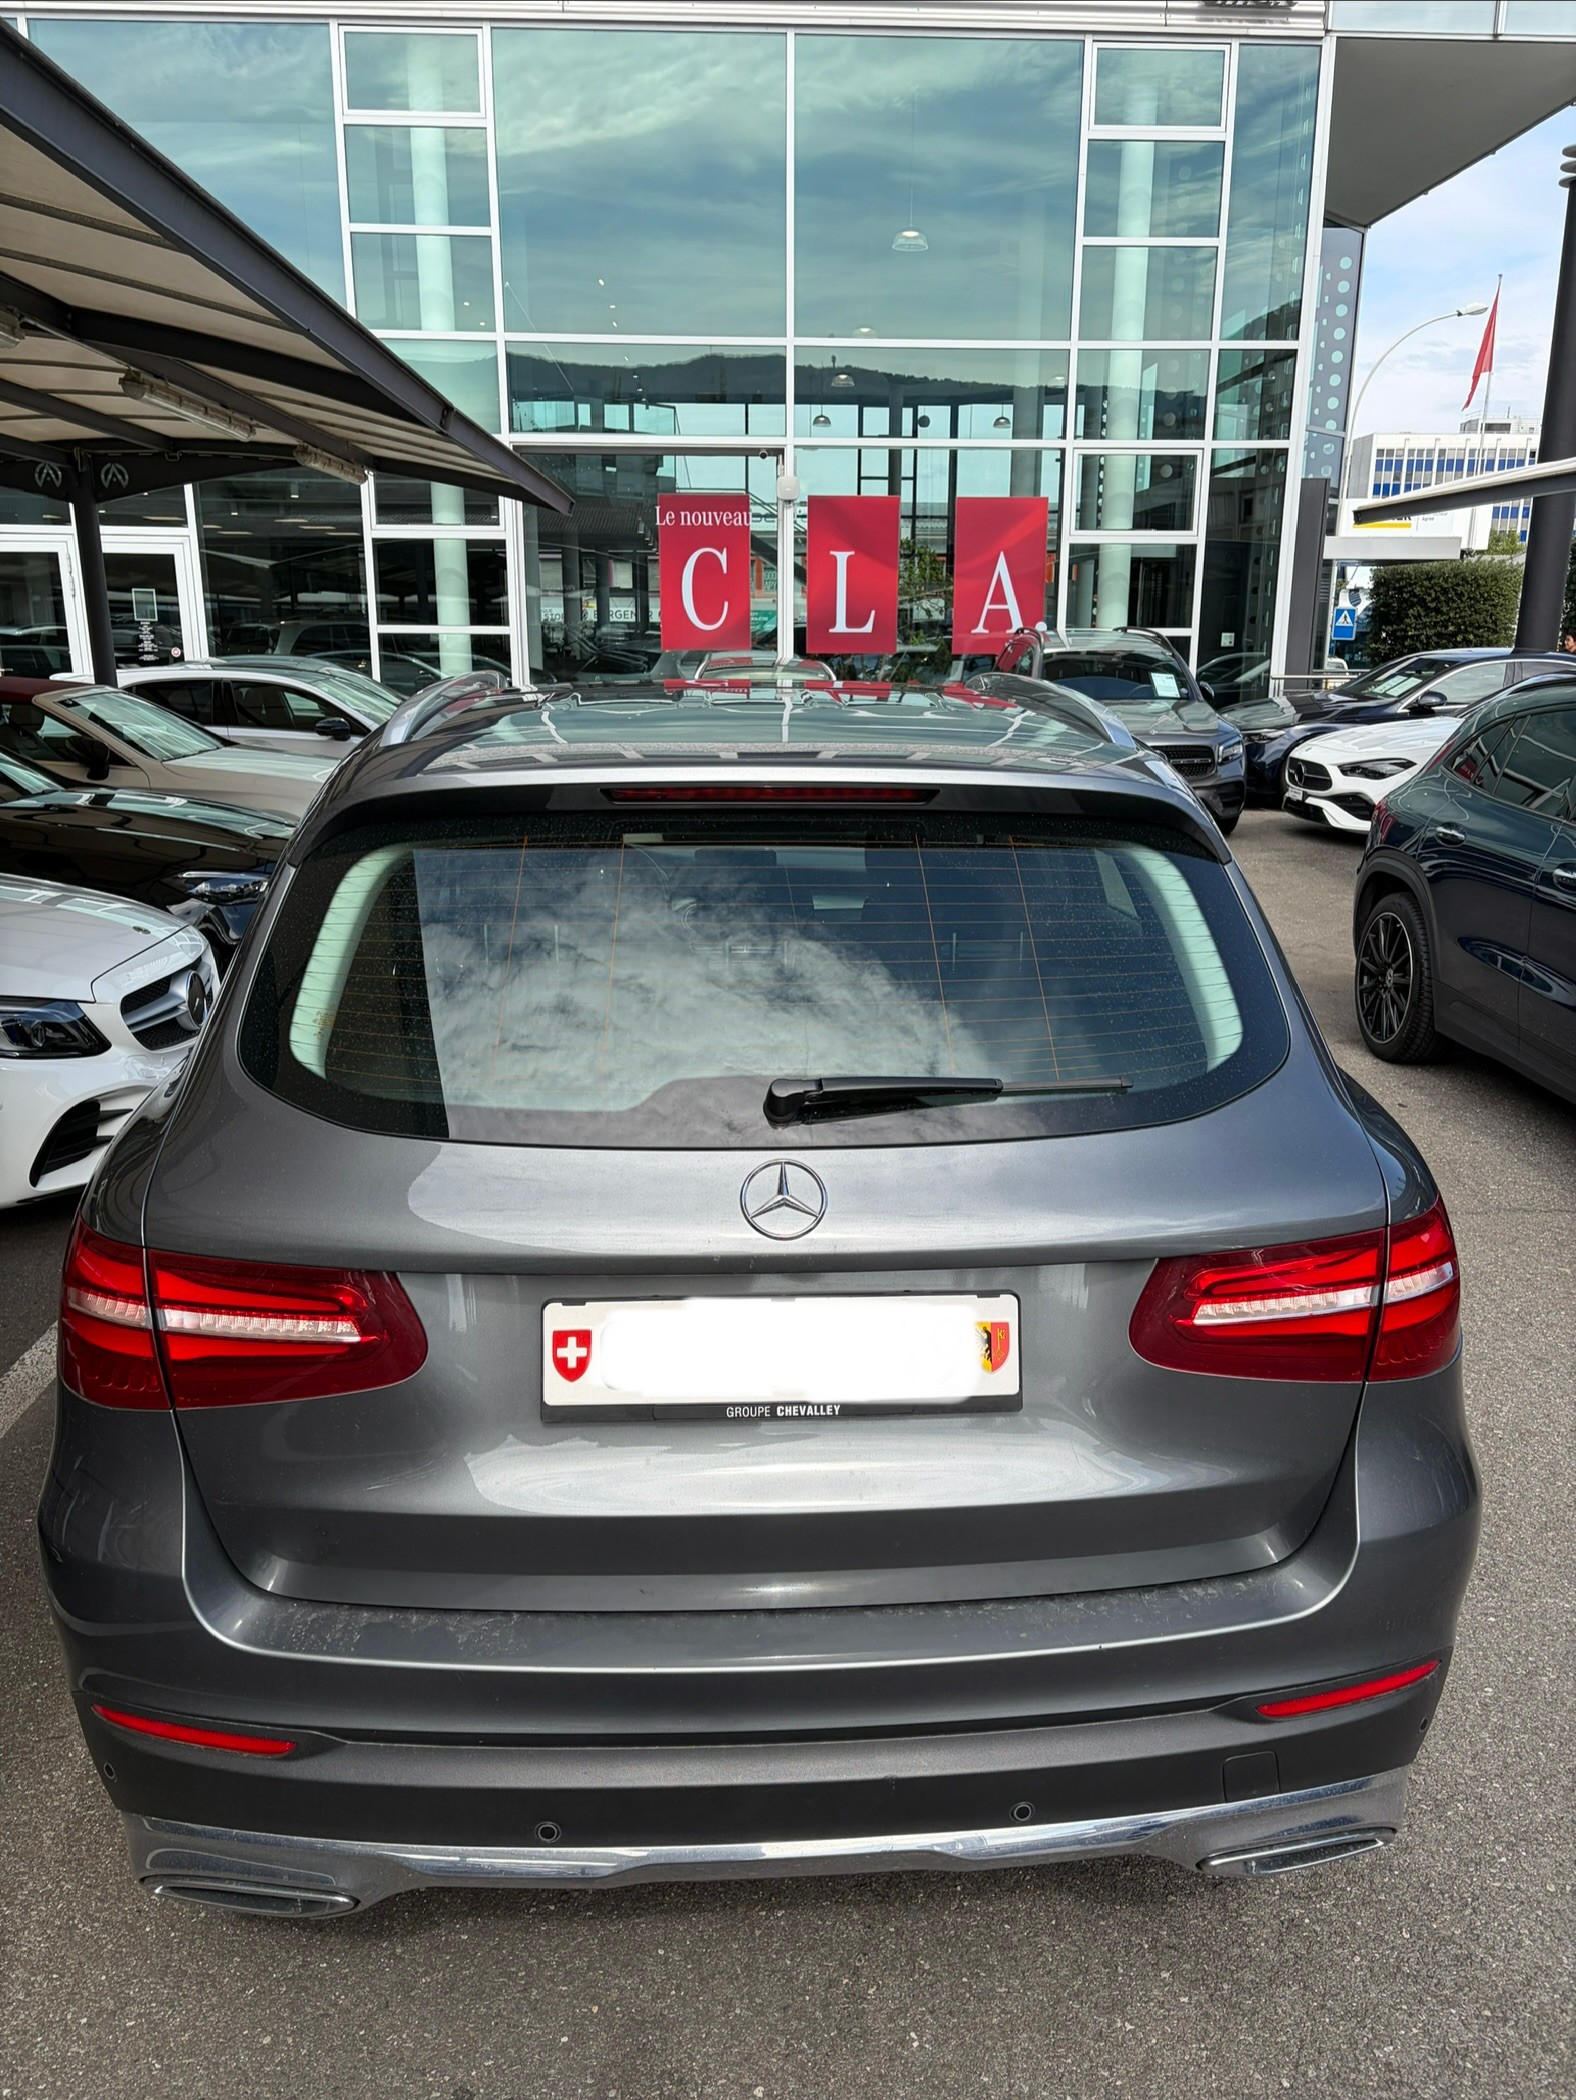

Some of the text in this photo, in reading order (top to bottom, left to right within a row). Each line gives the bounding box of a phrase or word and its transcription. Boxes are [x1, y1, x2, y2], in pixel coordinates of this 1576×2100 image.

[655, 505, 676, 526] Le
[680, 511, 753, 526] nouveau
[681, 547, 729, 631] C
[828, 550, 876, 634] L
[726, 1404, 841, 1418] GROUPE CHEVALLEY
